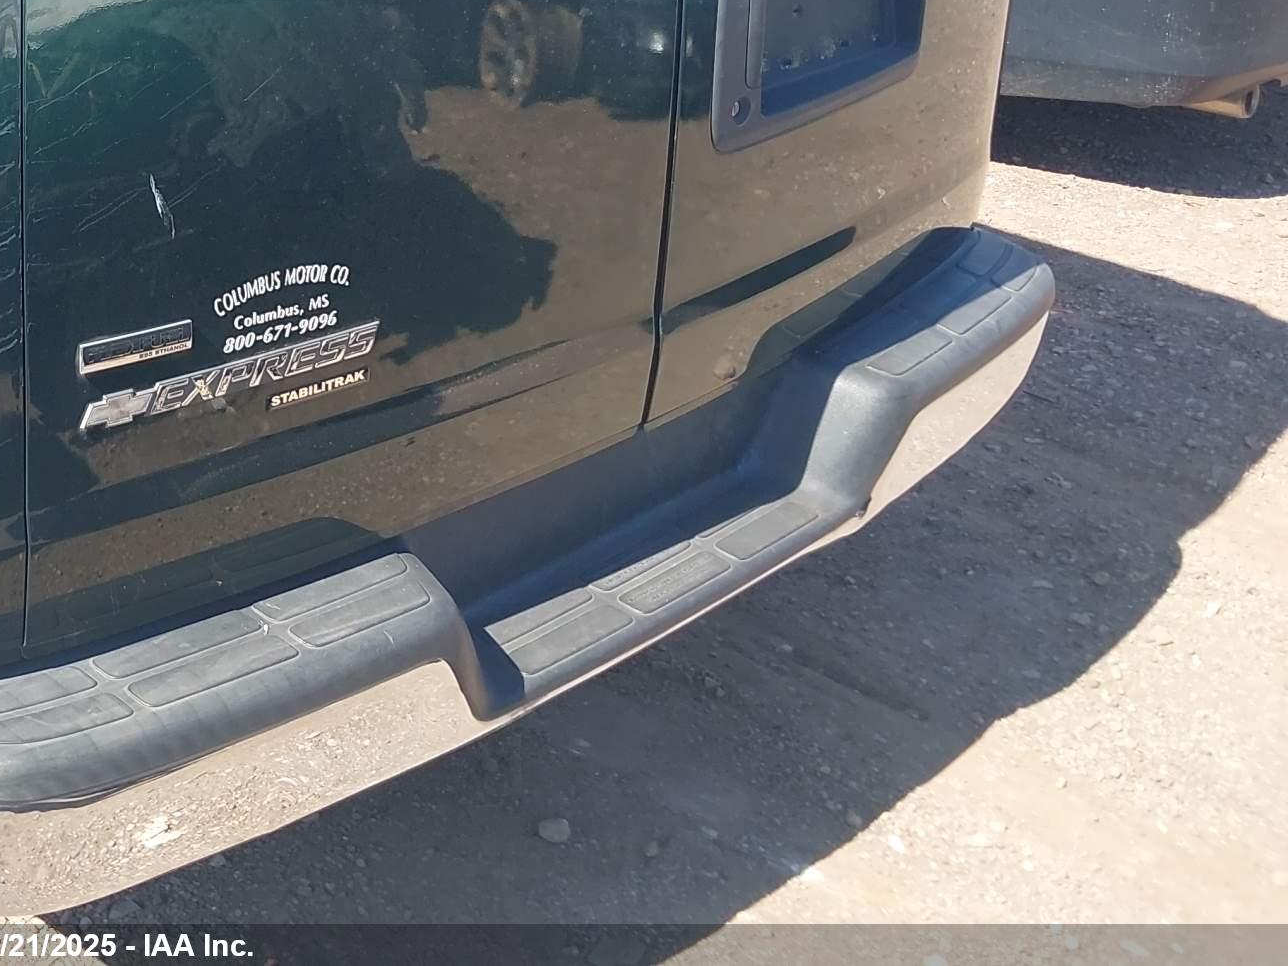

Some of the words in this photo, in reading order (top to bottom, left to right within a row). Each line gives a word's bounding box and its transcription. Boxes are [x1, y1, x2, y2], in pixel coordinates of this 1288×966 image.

[213, 270, 281, 316] COLUMBUS
[284, 264, 328, 286] MOTOR
[330, 264, 350, 286] CO.
[222, 310, 338, 354] 800-671-9096
[233, 304, 304, 330] Columbus,
[308, 294, 330, 311] MS
[151, 321, 380, 415] EXPRESS
[154, 342, 189, 356] ETHANOL
[270, 369, 366, 408] STABILITRAK
